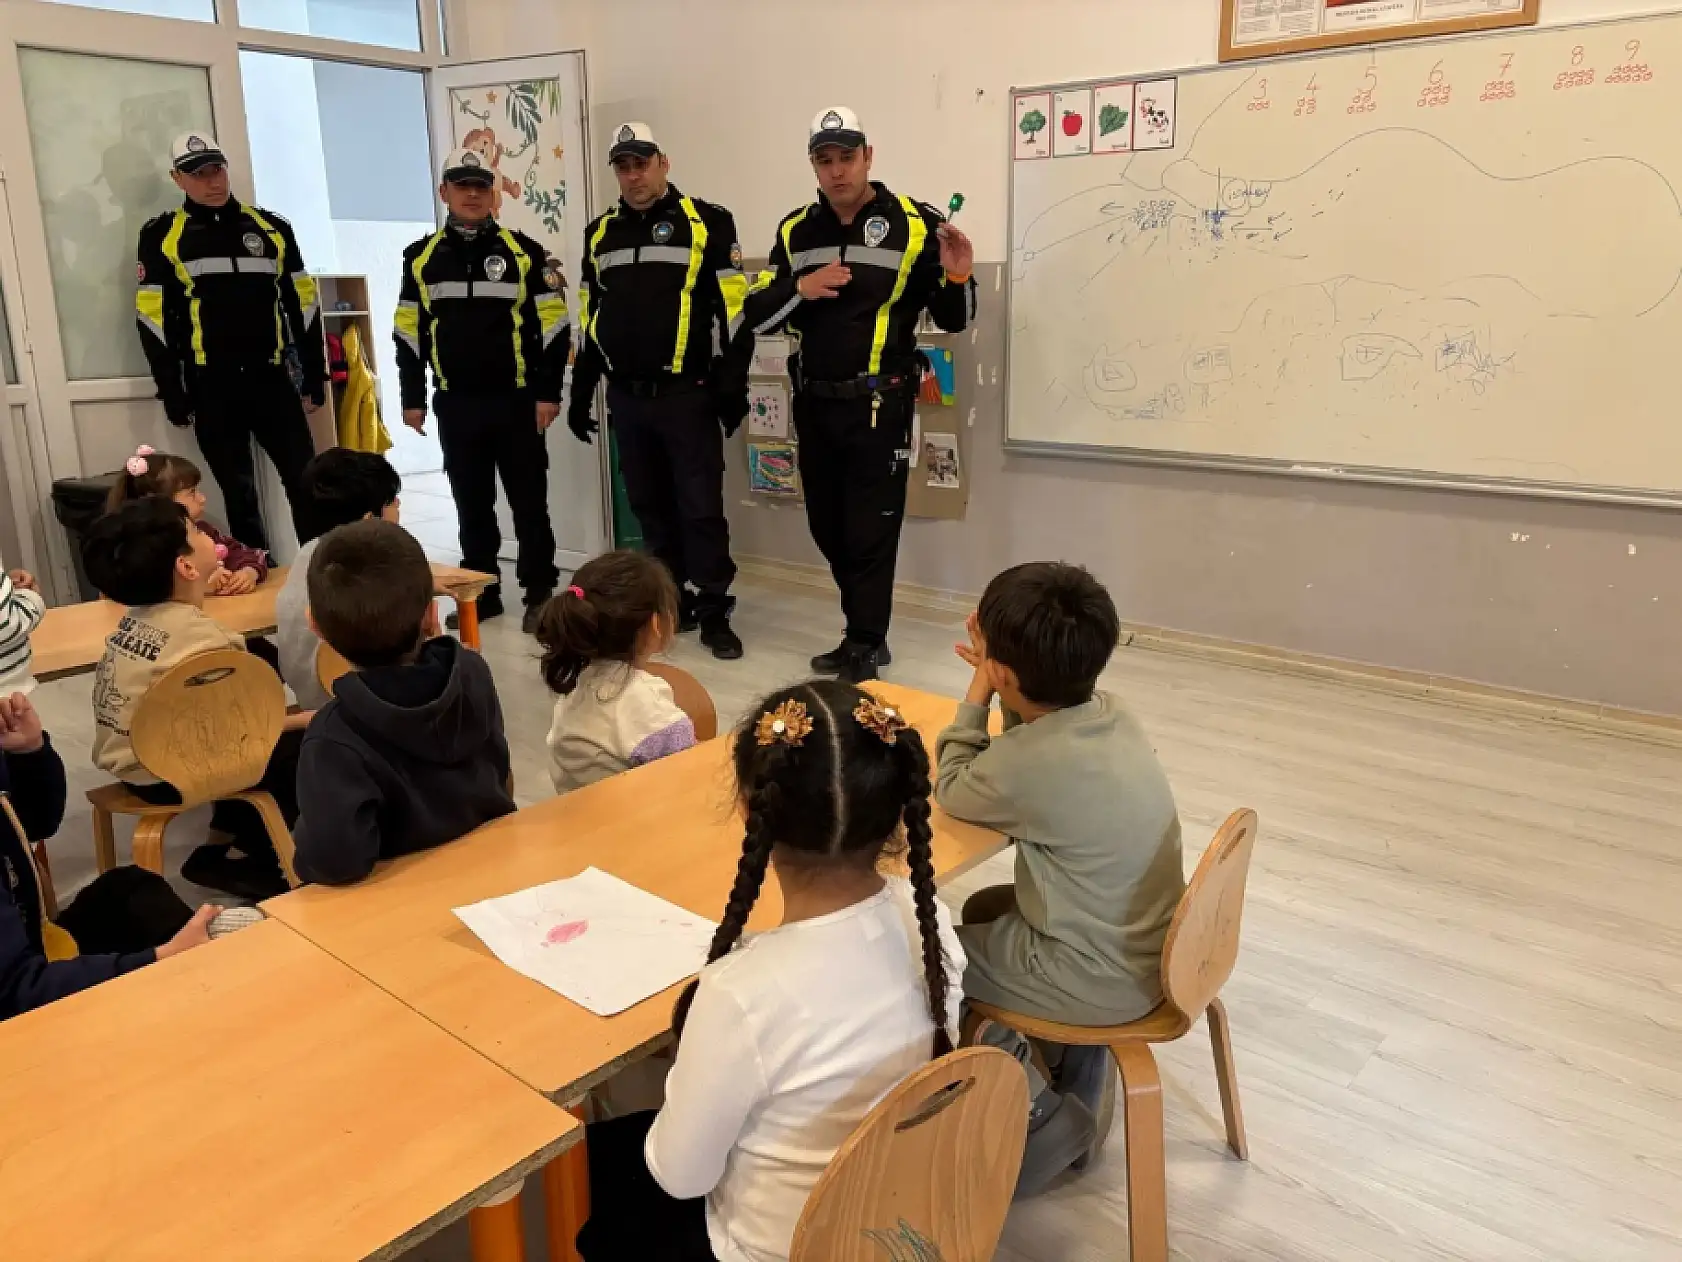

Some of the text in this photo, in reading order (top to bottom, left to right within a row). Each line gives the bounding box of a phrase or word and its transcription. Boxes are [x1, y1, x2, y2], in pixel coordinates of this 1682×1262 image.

[1252, 39, 1641, 100] 3 4 5 6 7 8 9
